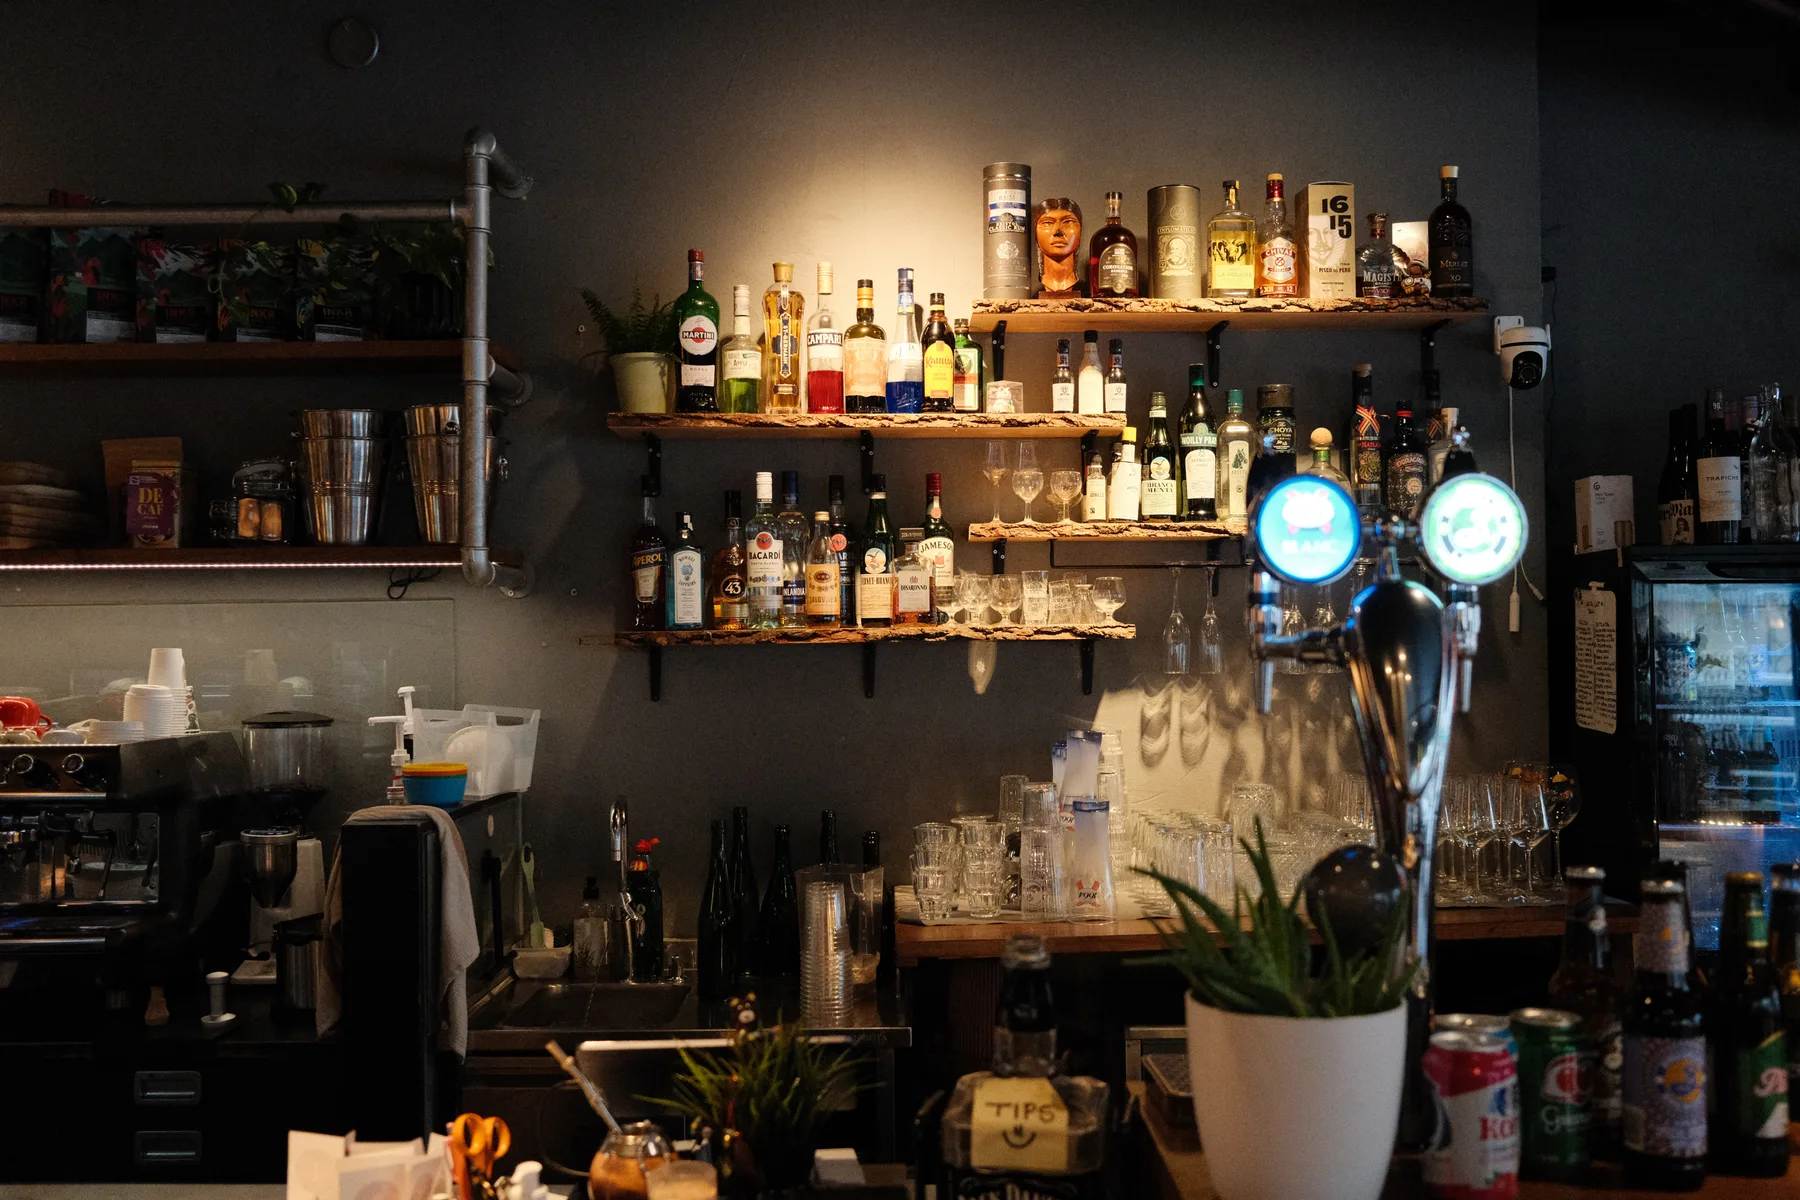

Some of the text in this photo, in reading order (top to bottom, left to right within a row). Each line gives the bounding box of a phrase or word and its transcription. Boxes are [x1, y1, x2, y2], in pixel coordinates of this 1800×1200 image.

[1322, 195, 1349, 214] 16
[1330, 215, 1352, 239] 15
[1265, 248, 1293, 256] CHIVAS
[1440, 260, 1468, 268] MERLET
[323, 307, 353, 317] INKA
[682, 331, 715, 340] MARTINI
[808, 333, 842, 345] CAMPARI
[925, 355, 953, 368] KAHLÚA
[1181, 436, 1202, 445] NOILLY
[138, 487, 164, 503] DE
[137, 503, 164, 515] CAF
[632, 553, 663, 566] APEROL
[749, 549, 781, 560] BACARDÍ
[724, 582, 742, 595] 43
[783, 588, 805, 596] NLANDIA
[985, 1101, 1056, 1124] TIPS
